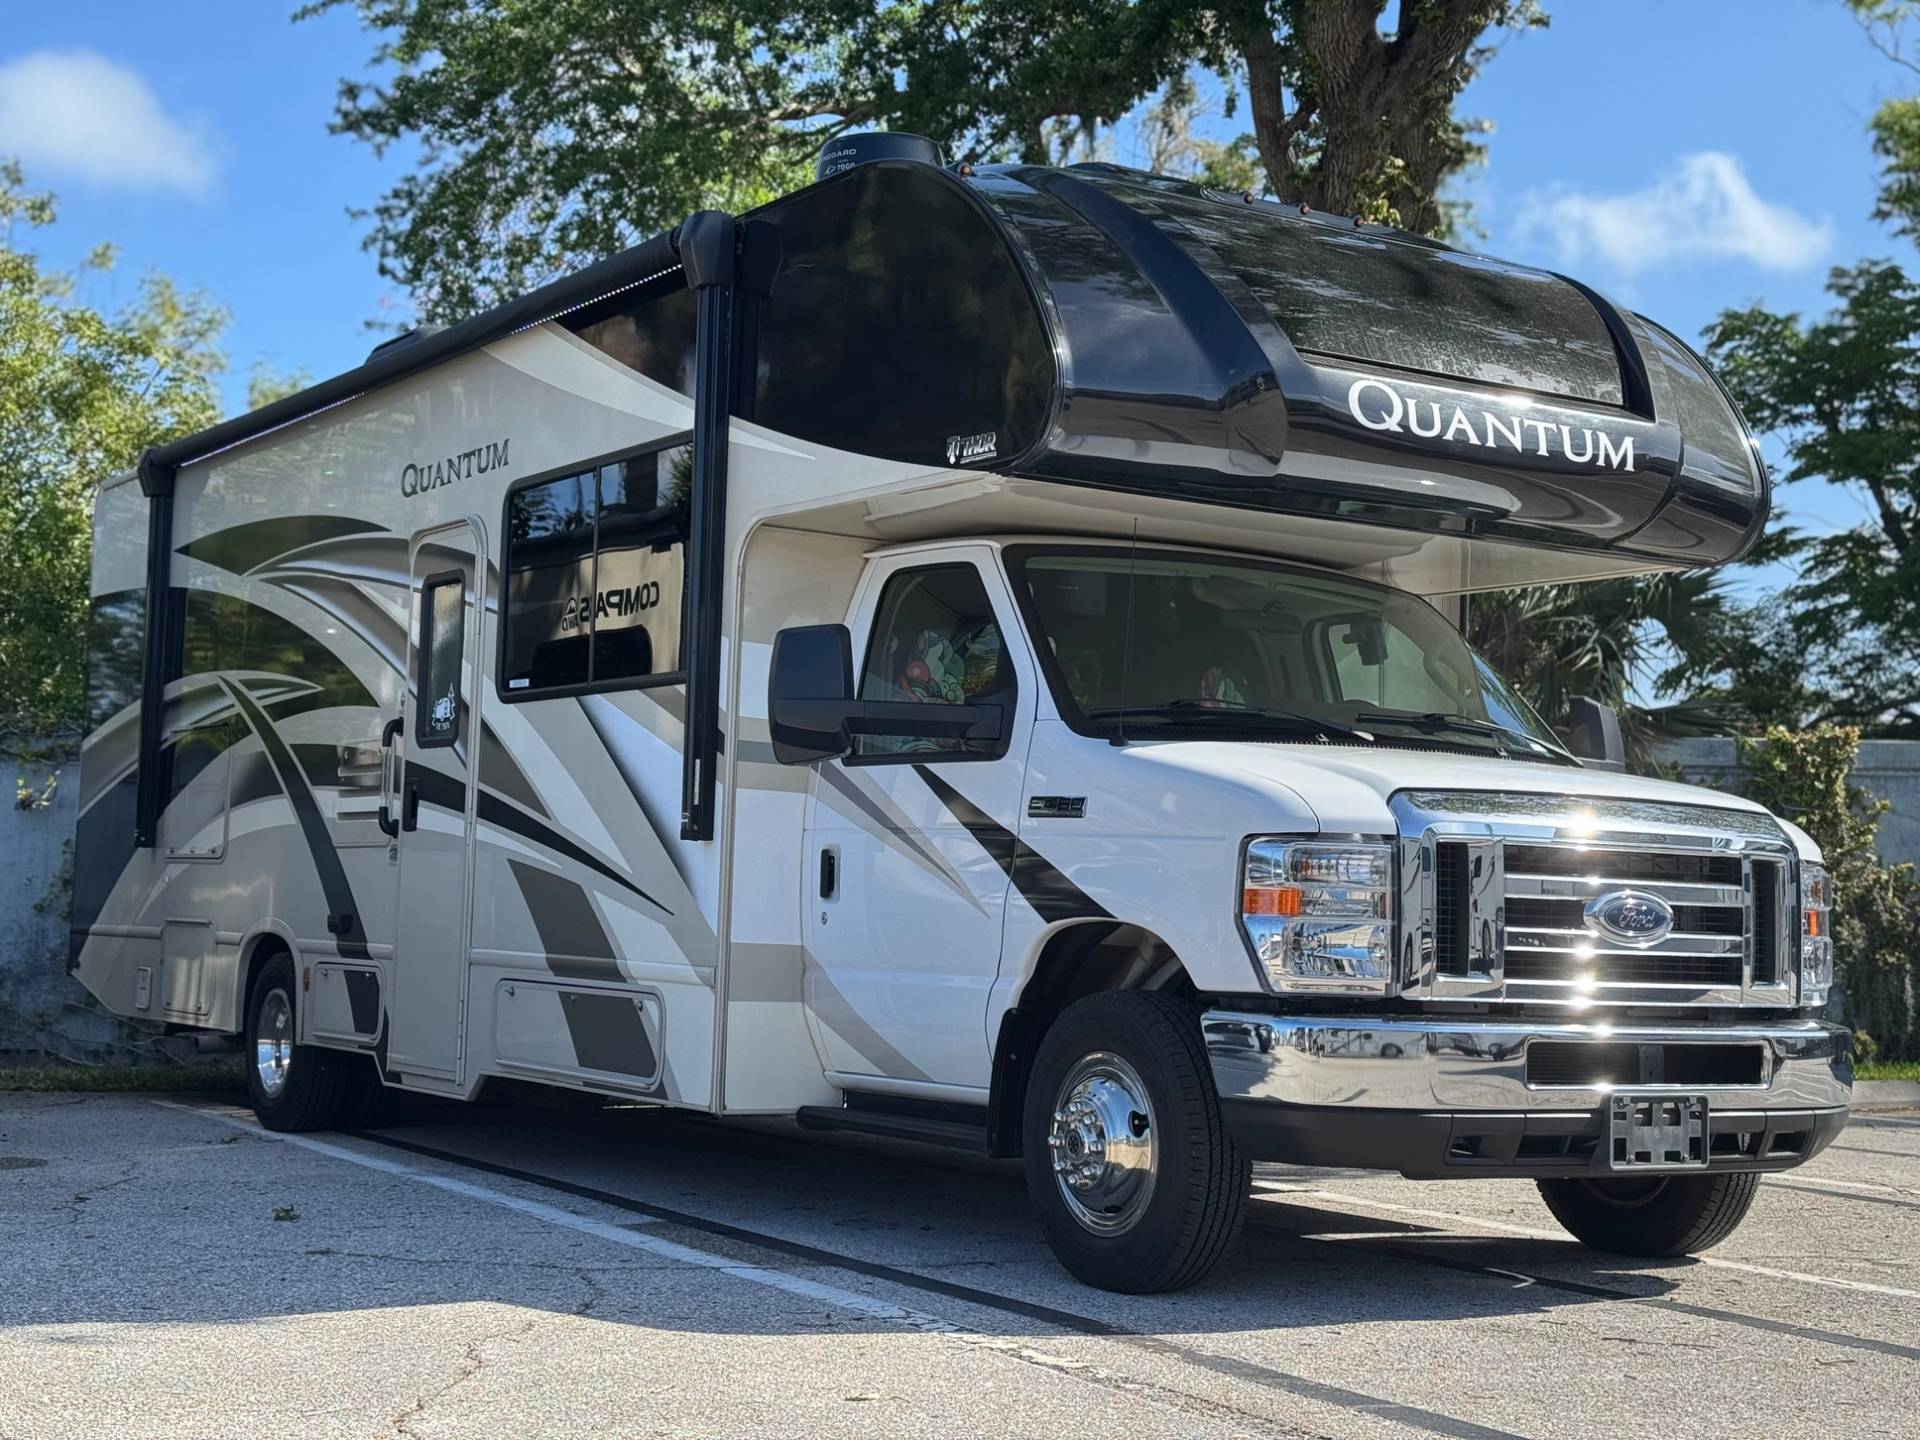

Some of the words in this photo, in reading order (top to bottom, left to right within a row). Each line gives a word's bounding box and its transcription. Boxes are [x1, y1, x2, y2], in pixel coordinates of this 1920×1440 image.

[960, 431, 996, 457] THOR
[1348, 379, 1635, 472] QUANTUM
[400, 438, 509, 498] QUANTUM
[1618, 902, 1656, 928] Ford
